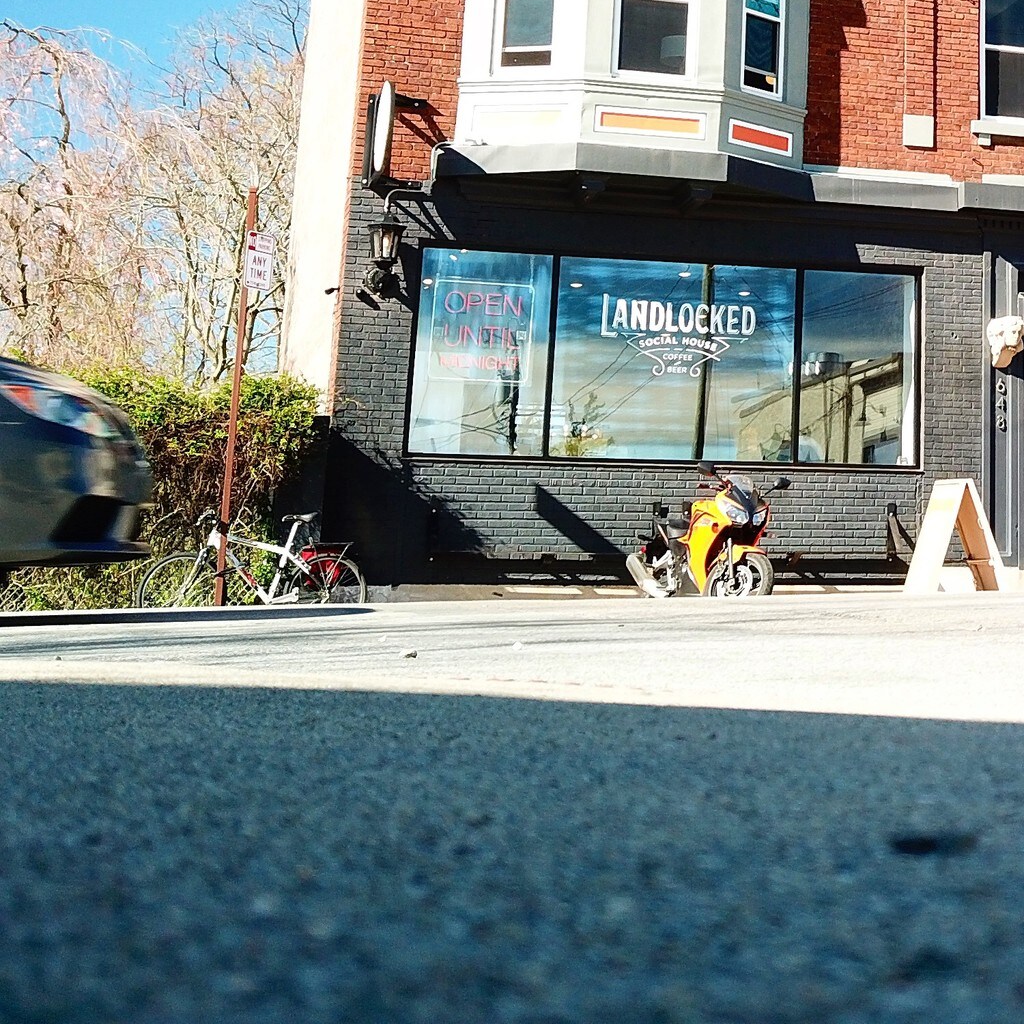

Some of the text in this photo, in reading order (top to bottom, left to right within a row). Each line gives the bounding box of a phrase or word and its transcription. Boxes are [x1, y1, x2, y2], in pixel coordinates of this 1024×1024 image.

[252, 255, 267, 267] ANY
[250, 267, 268, 281] TIME
[444, 290, 523, 317] OPEN
[600, 292, 757, 338] LANDLOCKED
[444, 323, 521, 350] UNTIL
[638, 336, 719, 352] SOCIAL HOUSE
[662, 352, 693, 361] COFFEE
[666, 366, 688, 374] BEER
[995, 377, 1006, 430] 648
